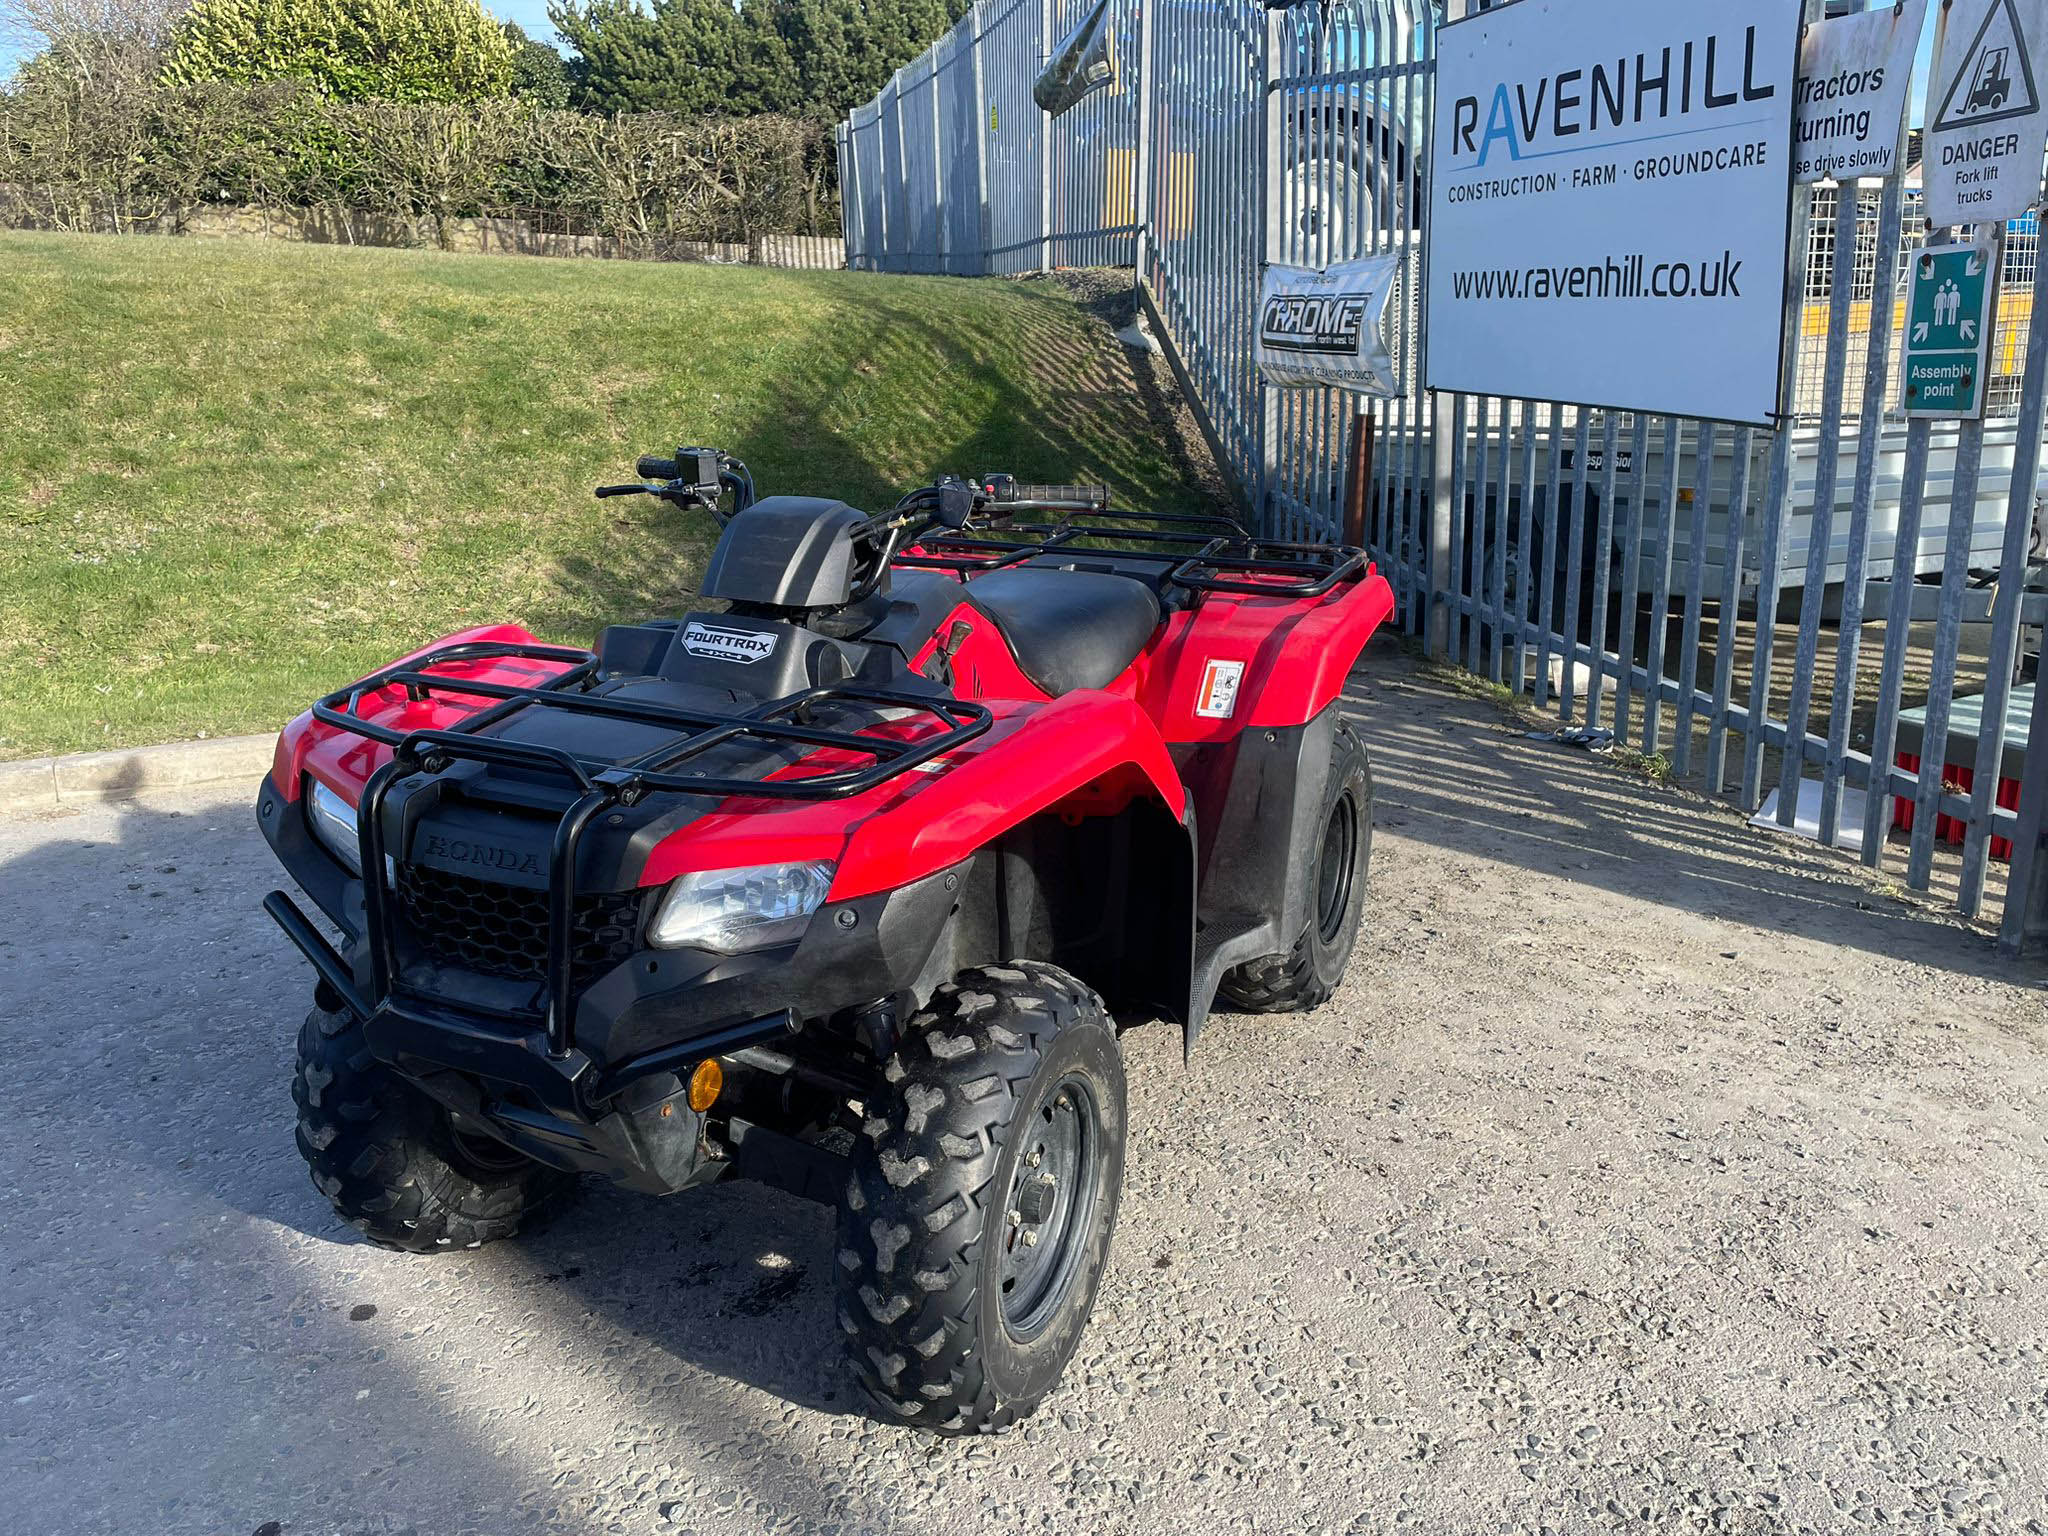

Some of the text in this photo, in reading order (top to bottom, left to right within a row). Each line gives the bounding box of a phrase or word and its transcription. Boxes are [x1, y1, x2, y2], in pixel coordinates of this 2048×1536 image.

[1452, 25, 1775, 166] RAVENHILL
[1796, 67, 1885, 105] Tractors
[1795, 108, 1870, 142] turning
[1815, 153, 1845, 171] drive
[1848, 146, 1891, 169] slowly
[1943, 134, 2019, 166] DANGER
[1448, 171, 1557, 204] CONSTRUCTION
[1572, 165, 1617, 187] FARM
[1633, 142, 1767, 181] GROUNDCARE
[1955, 165, 1999, 185] Fork lift
[1957, 188, 1993, 204] trucks
[1453, 250, 1743, 301] www.ravenhill.co.uk
[1263, 299, 1366, 338] CHROME
[1316, 366, 1343, 379] CLEANING
[1344, 370, 1376, 381] PRODUCTS
[1912, 364, 1972, 379] Assembly
[1924, 383, 1955, 399] point
[685, 632, 770, 653] FOURTRAX
[425, 835, 546, 876] HONDA
